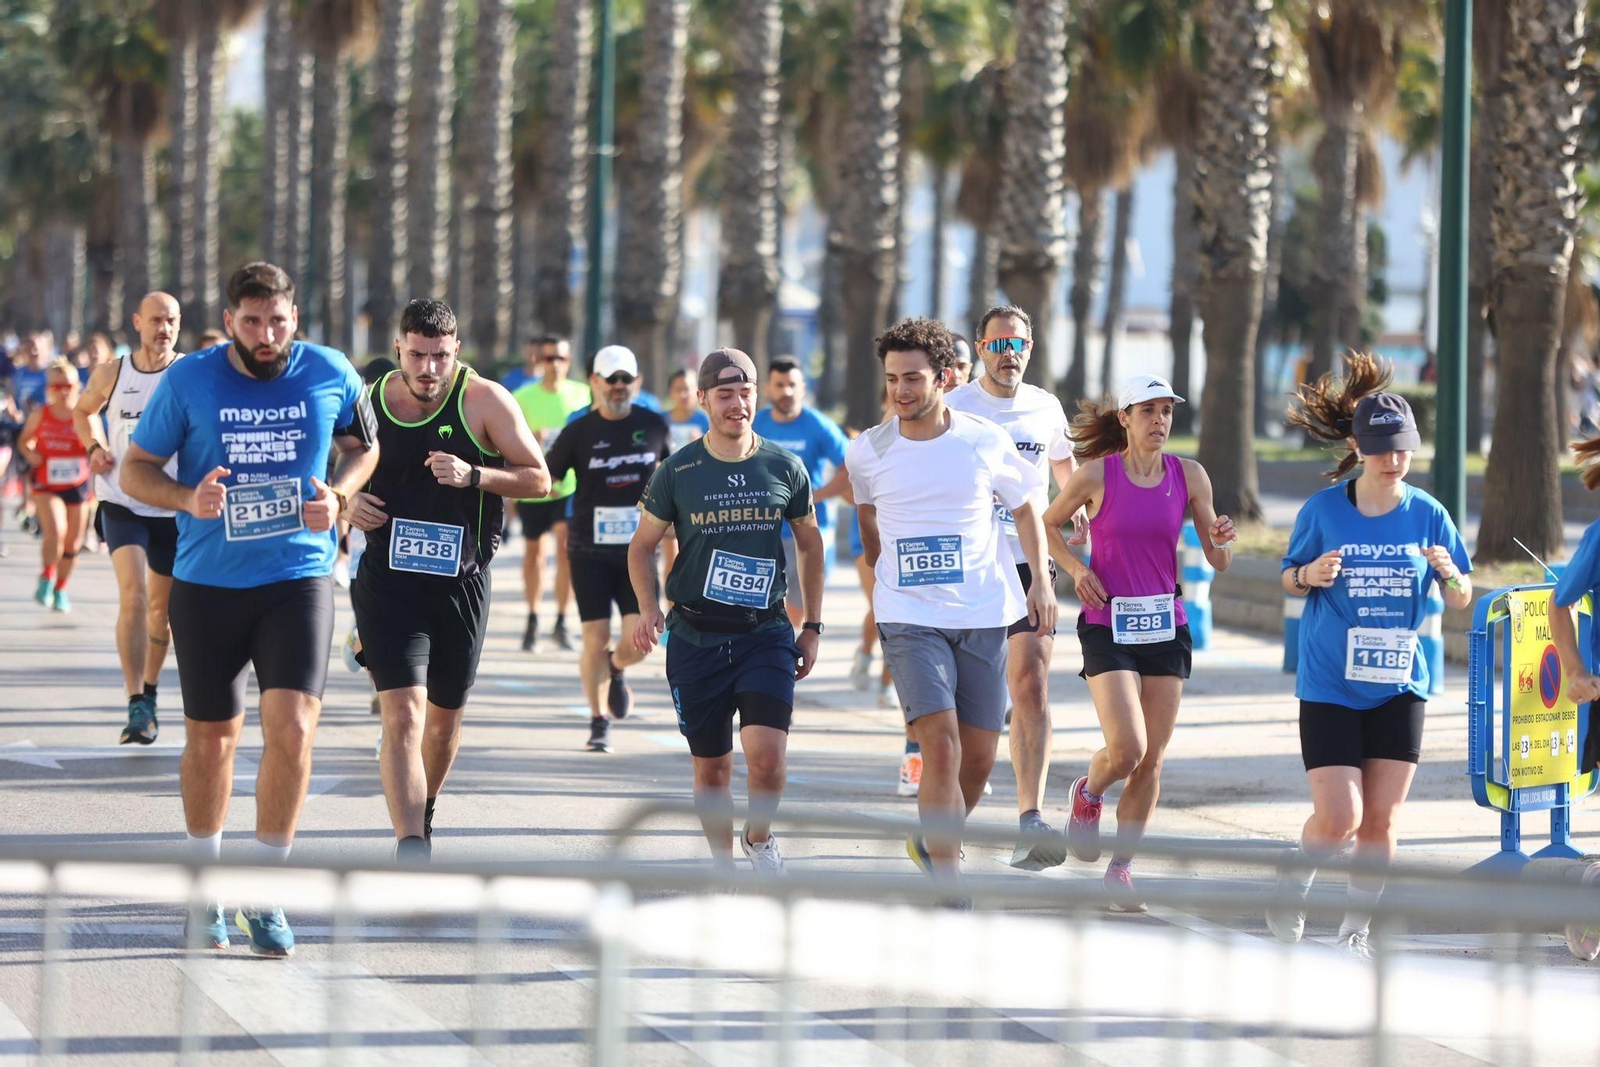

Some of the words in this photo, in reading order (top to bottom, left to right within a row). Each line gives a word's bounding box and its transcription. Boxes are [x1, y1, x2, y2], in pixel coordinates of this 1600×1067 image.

[220, 400, 307, 426] mayoral
[222, 430, 302, 443] RUNNING
[230, 440, 296, 453] MAKES
[1015, 442, 1045, 455] oup
[229, 450, 297, 464] FRIENDS
[704, 493, 735, 501] SIERRA
[719, 499, 758, 507] ESTATES
[235, 499, 292, 521] 2139
[690, 507, 782, 526] MARBELLA
[405, 530, 429, 538] Solidaria
[438, 527, 459, 535] mayoral
[701, 526, 724, 535] HALF
[726, 523, 775, 534] MARATHON
[399, 539, 453, 558] 2138
[724, 562, 747, 572] Solidaria
[725, 557, 745, 566] Carrera
[905, 553, 955, 570] 1685
[1342, 566, 1417, 577] RUNNING
[718, 571, 765, 591] 1694
[1349, 577, 1412, 588] MAKES
[1348, 587, 1412, 598] FRIENDS
[1524, 598, 1548, 617] POLICÍ
[1126, 615, 1162, 630] 298
[1535, 621, 1553, 641] MÁL
[1357, 650, 1410, 668] 1186
[1512, 714, 1534, 725] PROHIBIDO
[1535, 712, 1561, 722] ESTACIONAR
[1561, 710, 1575, 720] DESDE
[1512, 741, 1520, 751] LAS
[1521, 740, 1529, 753] 23
[1534, 739, 1542, 749] DEL
[1511, 767, 1520, 777] CON
